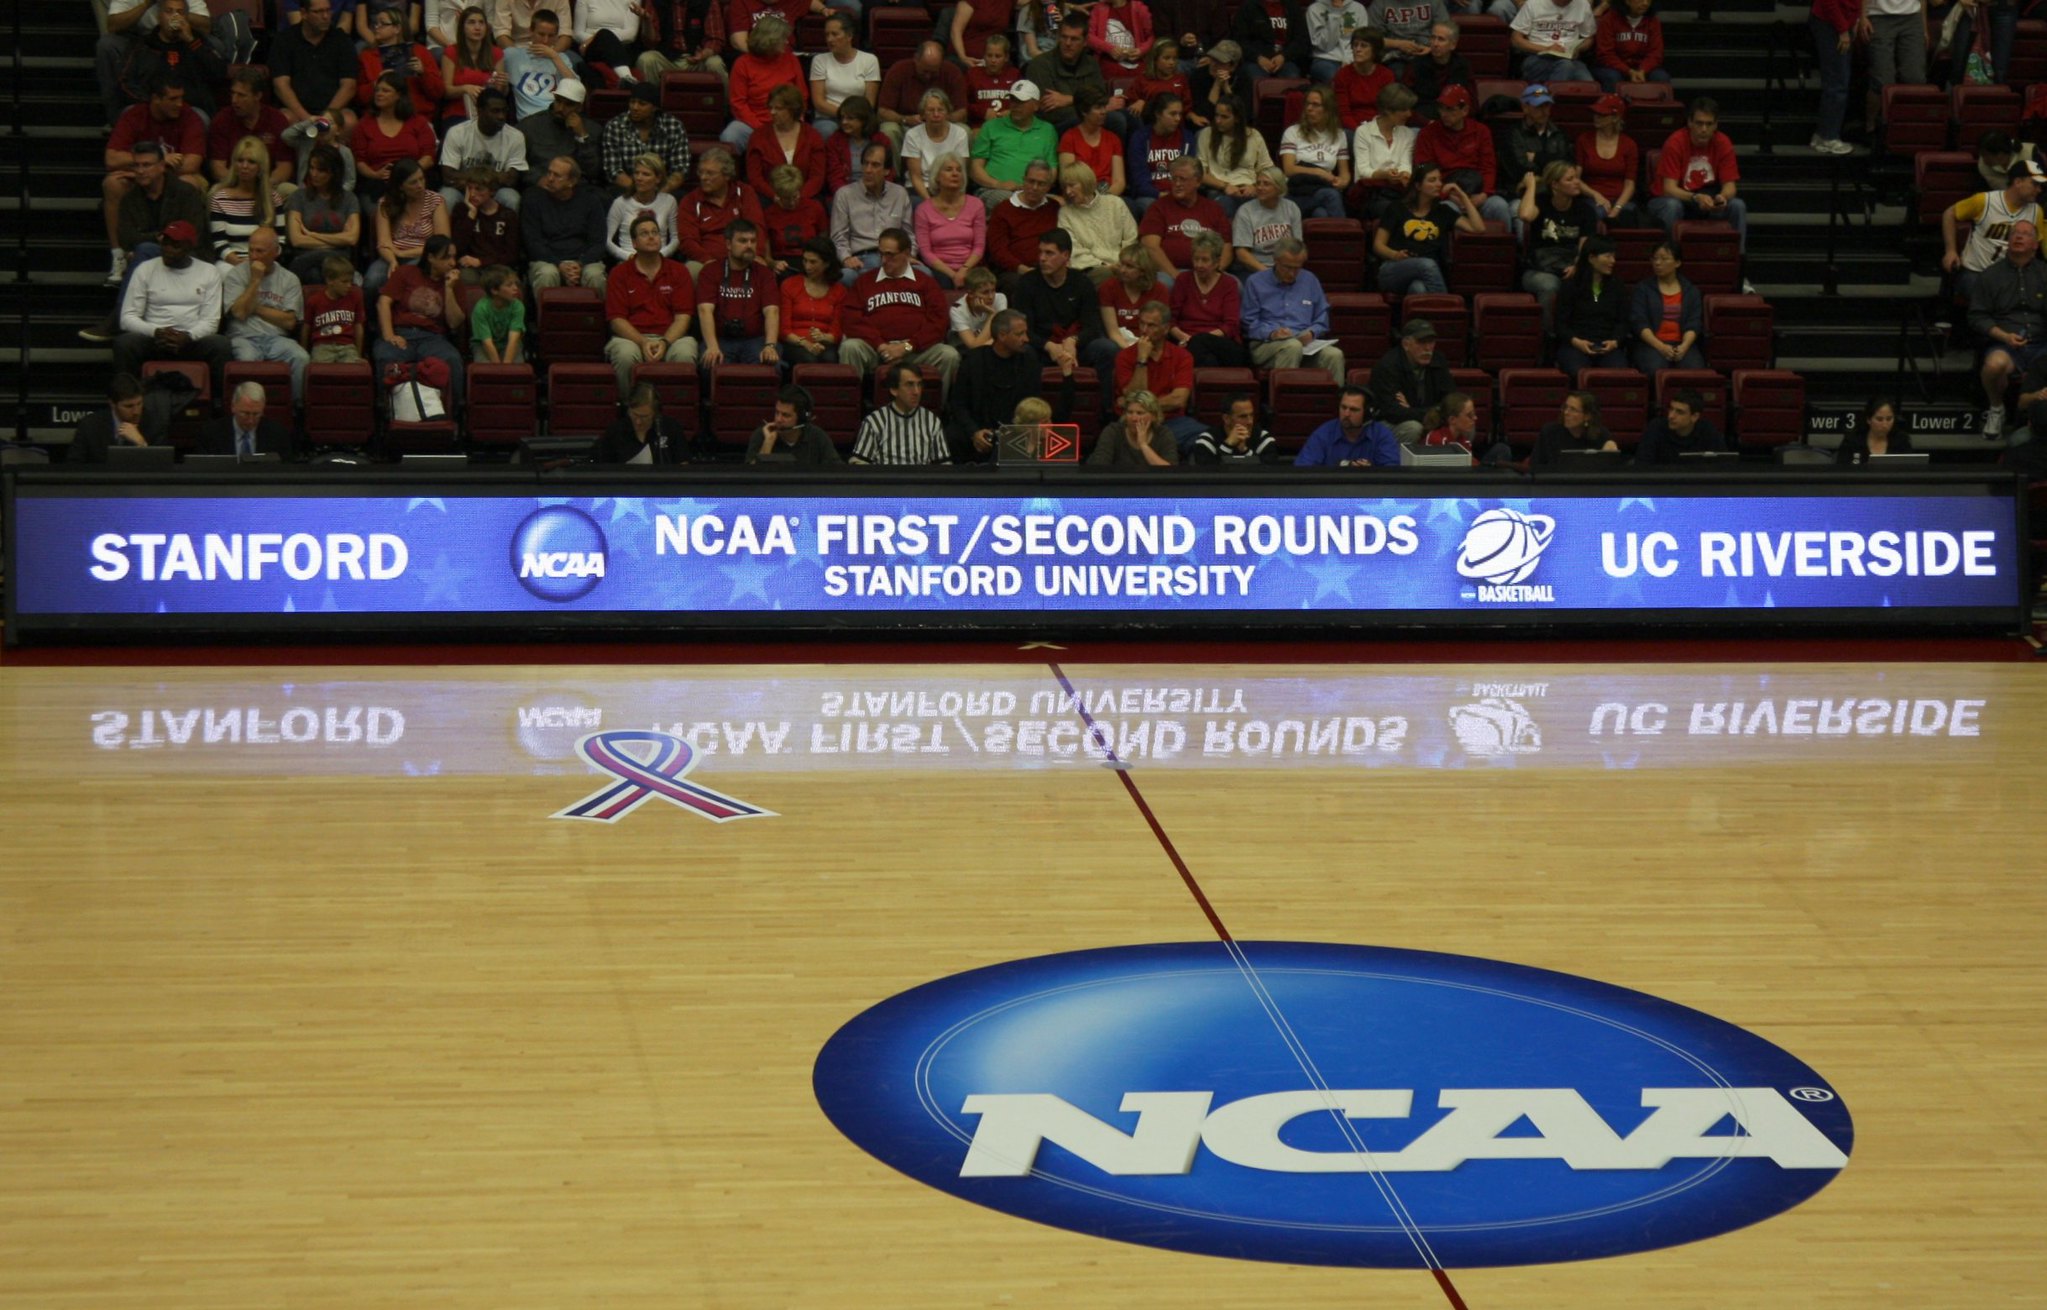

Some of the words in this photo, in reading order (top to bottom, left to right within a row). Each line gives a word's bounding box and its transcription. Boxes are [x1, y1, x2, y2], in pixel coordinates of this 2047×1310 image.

[1384, 4, 1431, 24] APU
[867, 291, 922, 312] STANFORD
[1845, 413, 1856, 430] 3
[1912, 413, 1957, 430] Lower
[1963, 413, 1974, 430] 2
[818, 514, 1196, 563] FIRST/SECOND
[1214, 514, 1419, 556] ROUNDS
[91, 532, 409, 581] STANFORD
[520, 551, 605, 579] NCAA
[1601, 531, 1679, 578] UC
[1700, 530, 1996, 577] RIVERSIDE
[824, 565, 1022, 597] STANFORD
[1035, 565, 1256, 597] UNIVERSITY
[1478, 584, 1555, 603] BASKETBALL
